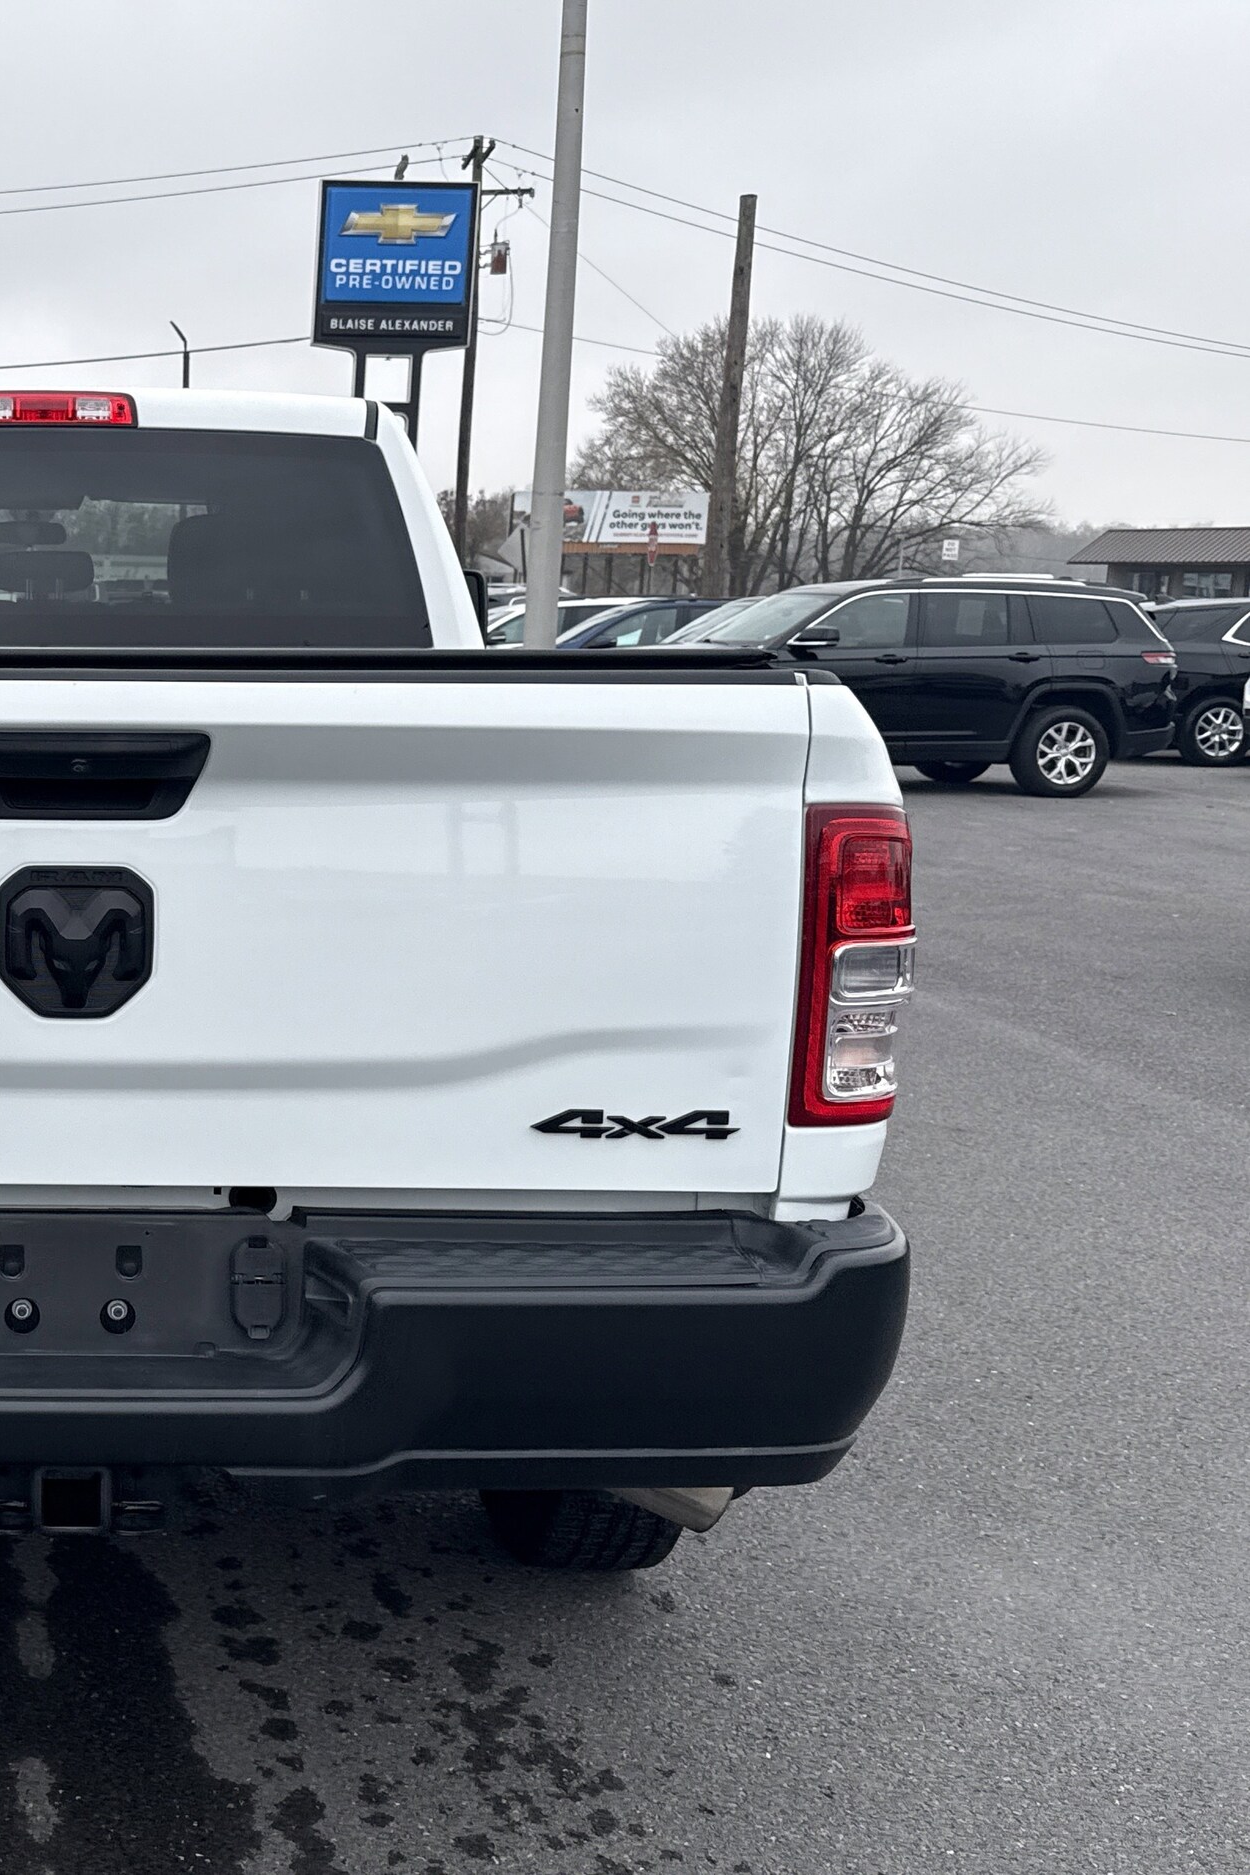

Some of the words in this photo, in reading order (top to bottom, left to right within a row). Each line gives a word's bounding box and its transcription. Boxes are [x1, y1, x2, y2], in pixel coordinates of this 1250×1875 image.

[330, 258, 462, 275] CERTIFIED
[335, 274, 454, 290] PRE-OWNED
[330, 318, 375, 330] BLAISE
[379, 319, 454, 332] ALEXANDER
[612, 509, 646, 521] Going
[648, 510, 681, 519] where
[683, 511, 702, 520] the
[609, 520, 639, 529] other
[30, 870, 125, 882] RAM
[530, 1108, 741, 1139] 4x4
